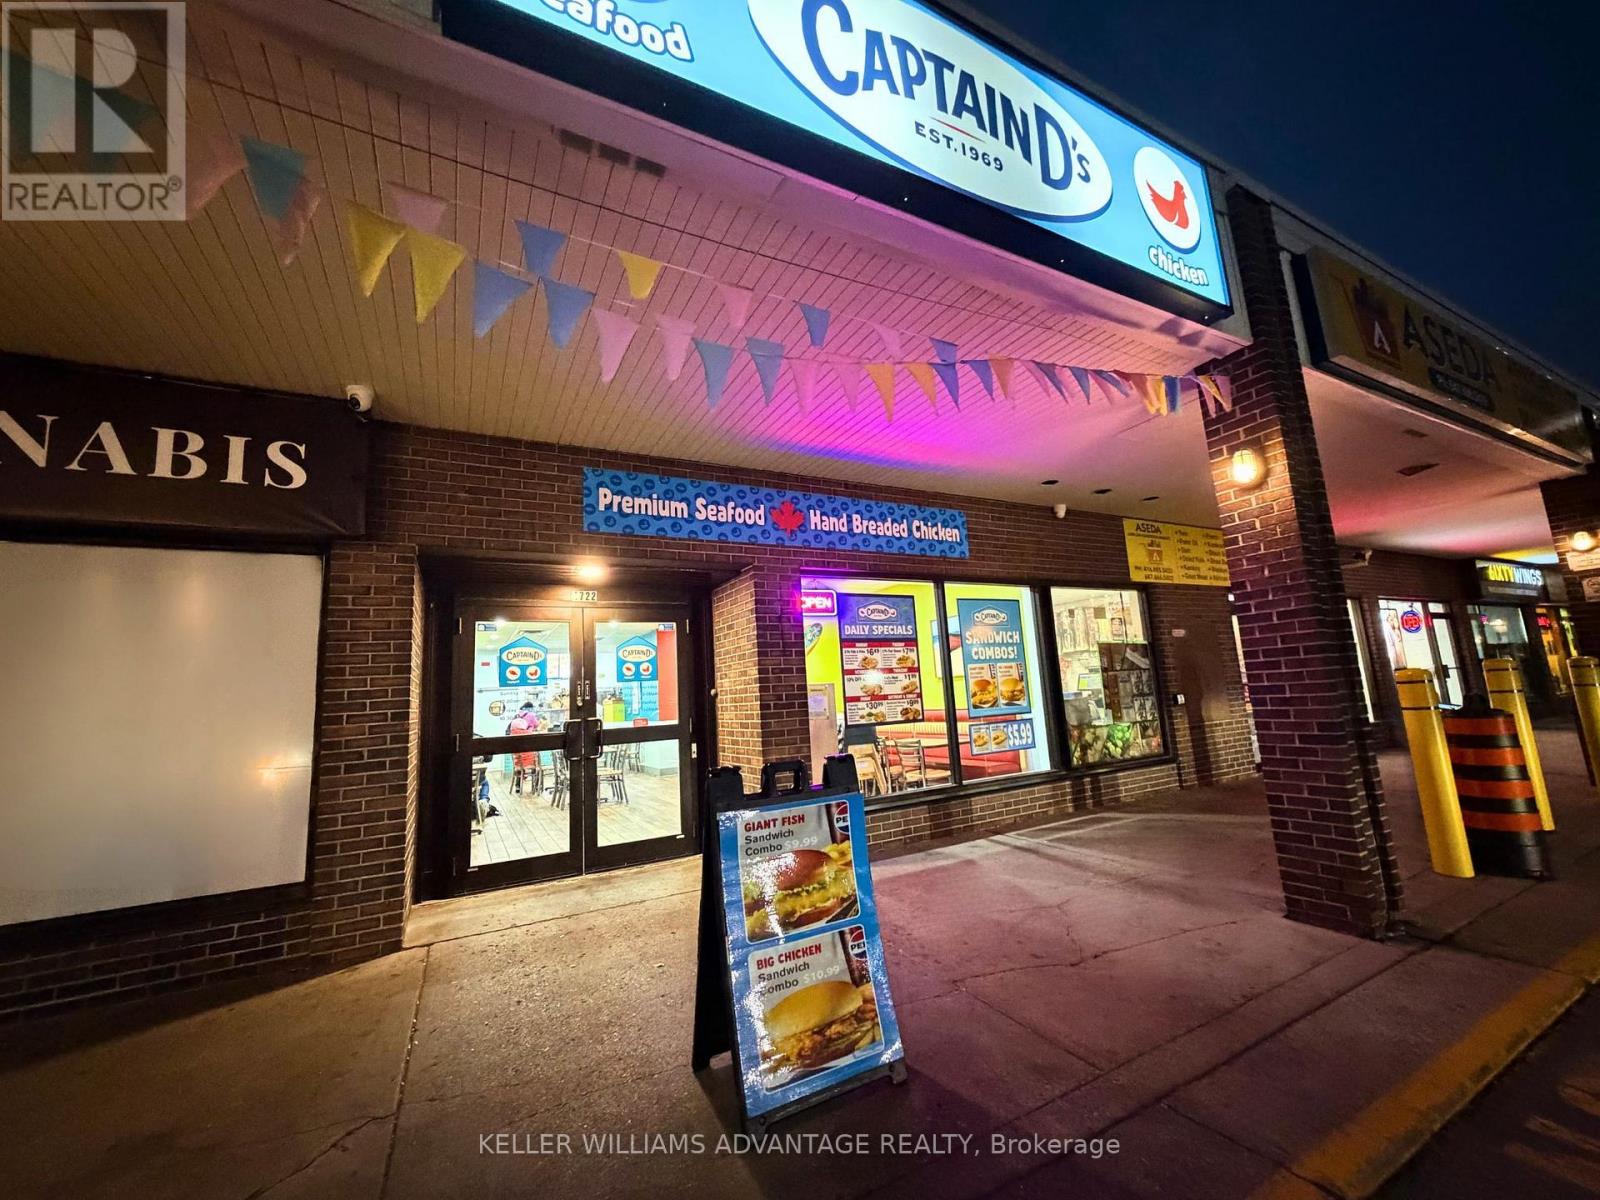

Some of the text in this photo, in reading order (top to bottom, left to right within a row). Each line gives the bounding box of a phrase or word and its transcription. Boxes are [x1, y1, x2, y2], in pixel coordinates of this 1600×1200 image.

[1148, 245, 1209, 286] chicken
[1403, 305, 1496, 383] ASEDA
[598, 487, 961, 542] Premium Seafood Hand Breaded Chicken
[1135, 522, 1162, 534] ASEDA
[800, 595, 832, 609] OPEN
[844, 624, 913, 636] DAILY SPECIALS
[965, 630, 1020, 645] SANDWICH
[971, 645, 1018, 660] COMBOS!
[1007, 724, 1032, 745] $5.99
[744, 814, 806, 832] GIANT FISH
[744, 828, 795, 845] Sandwich
[745, 836, 818, 856] Combo $9.99
[756, 943, 823, 970] BIG CHICKEN
[758, 962, 811, 982] Sandwich
[803, 965, 840, 984] $10.99
